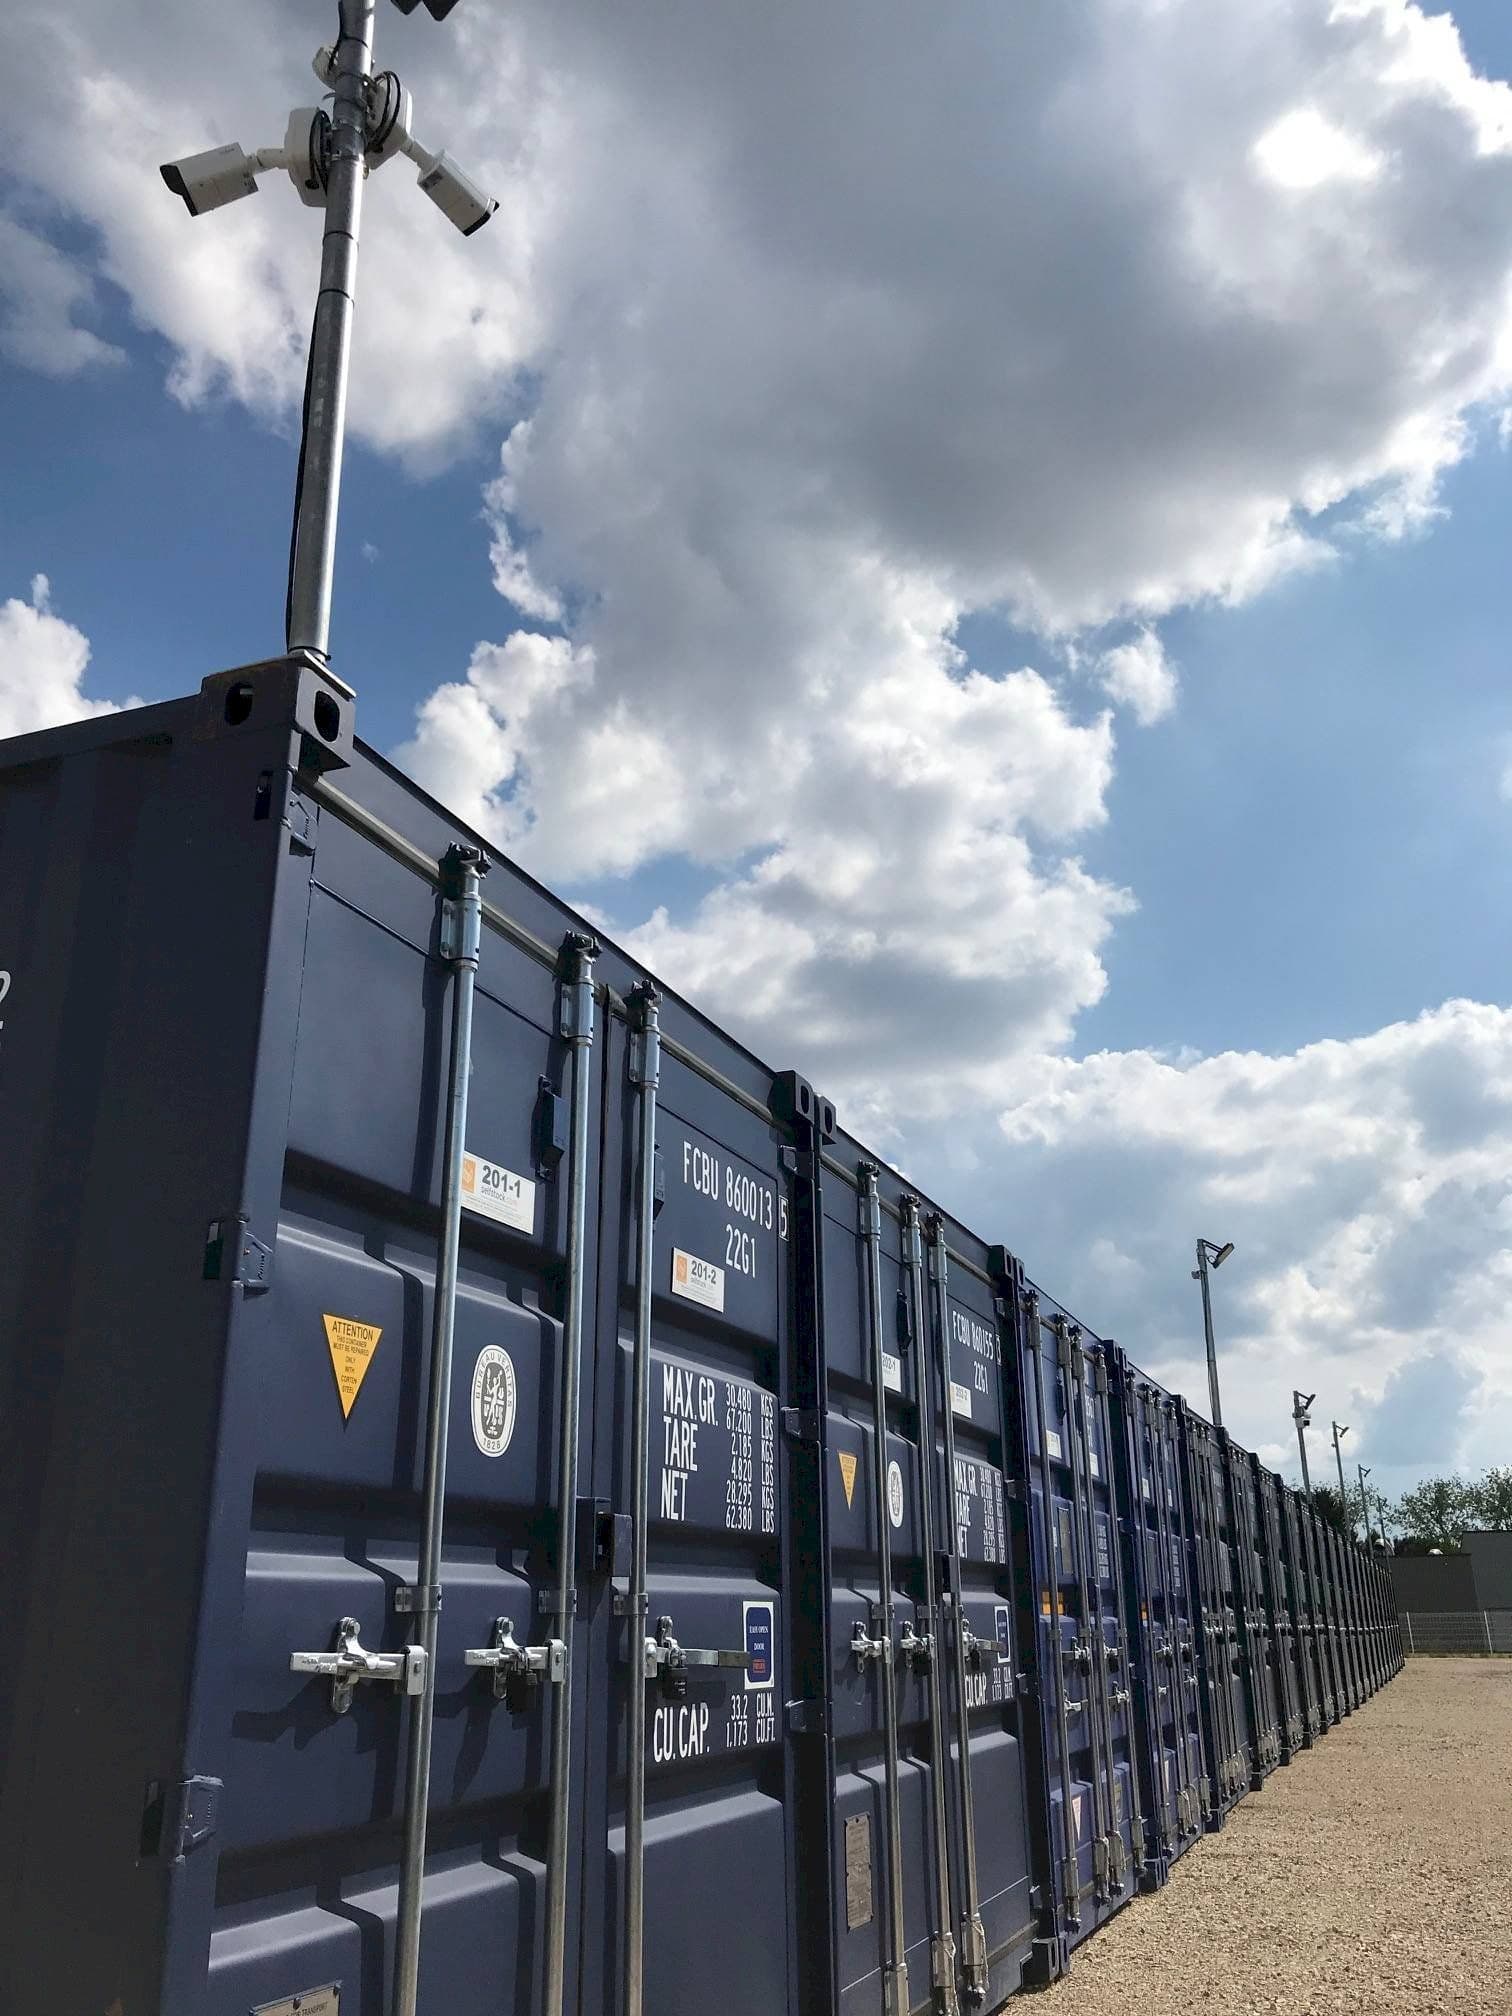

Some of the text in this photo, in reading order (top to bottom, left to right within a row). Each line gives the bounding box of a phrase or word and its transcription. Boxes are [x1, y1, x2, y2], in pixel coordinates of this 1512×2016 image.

[481, 1165, 521, 1198] 201-1
[683, 1140, 719, 1201] FCBU
[725, 1166, 772, 1230] 860013
[725, 1223, 756, 1279] 22G1
[691, 1260, 717, 1285] 201-2
[332, 1320, 374, 1342] ATTENTION
[475, 1352, 513, 1408] BUREAU VERITAS
[663, 1364, 774, 1426] MAX. GR. 30.480 KGS
[726, 1407, 774, 1441] 67.200 LBS
[483, 1438, 501, 1450] 1828
[663, 1415, 774, 1472] TARE 2.185 KGS
[731, 1456, 774, 1486] 4.820 LBS
[660, 1467, 775, 1521] NET 28.295 KGS
[726, 1505, 775, 1533] 62.380 LBS
[653, 1692, 775, 1763] CU. CAP. 33.2 CU.M.
[726, 1717, 776, 1748] 1.173 CU.FT.
